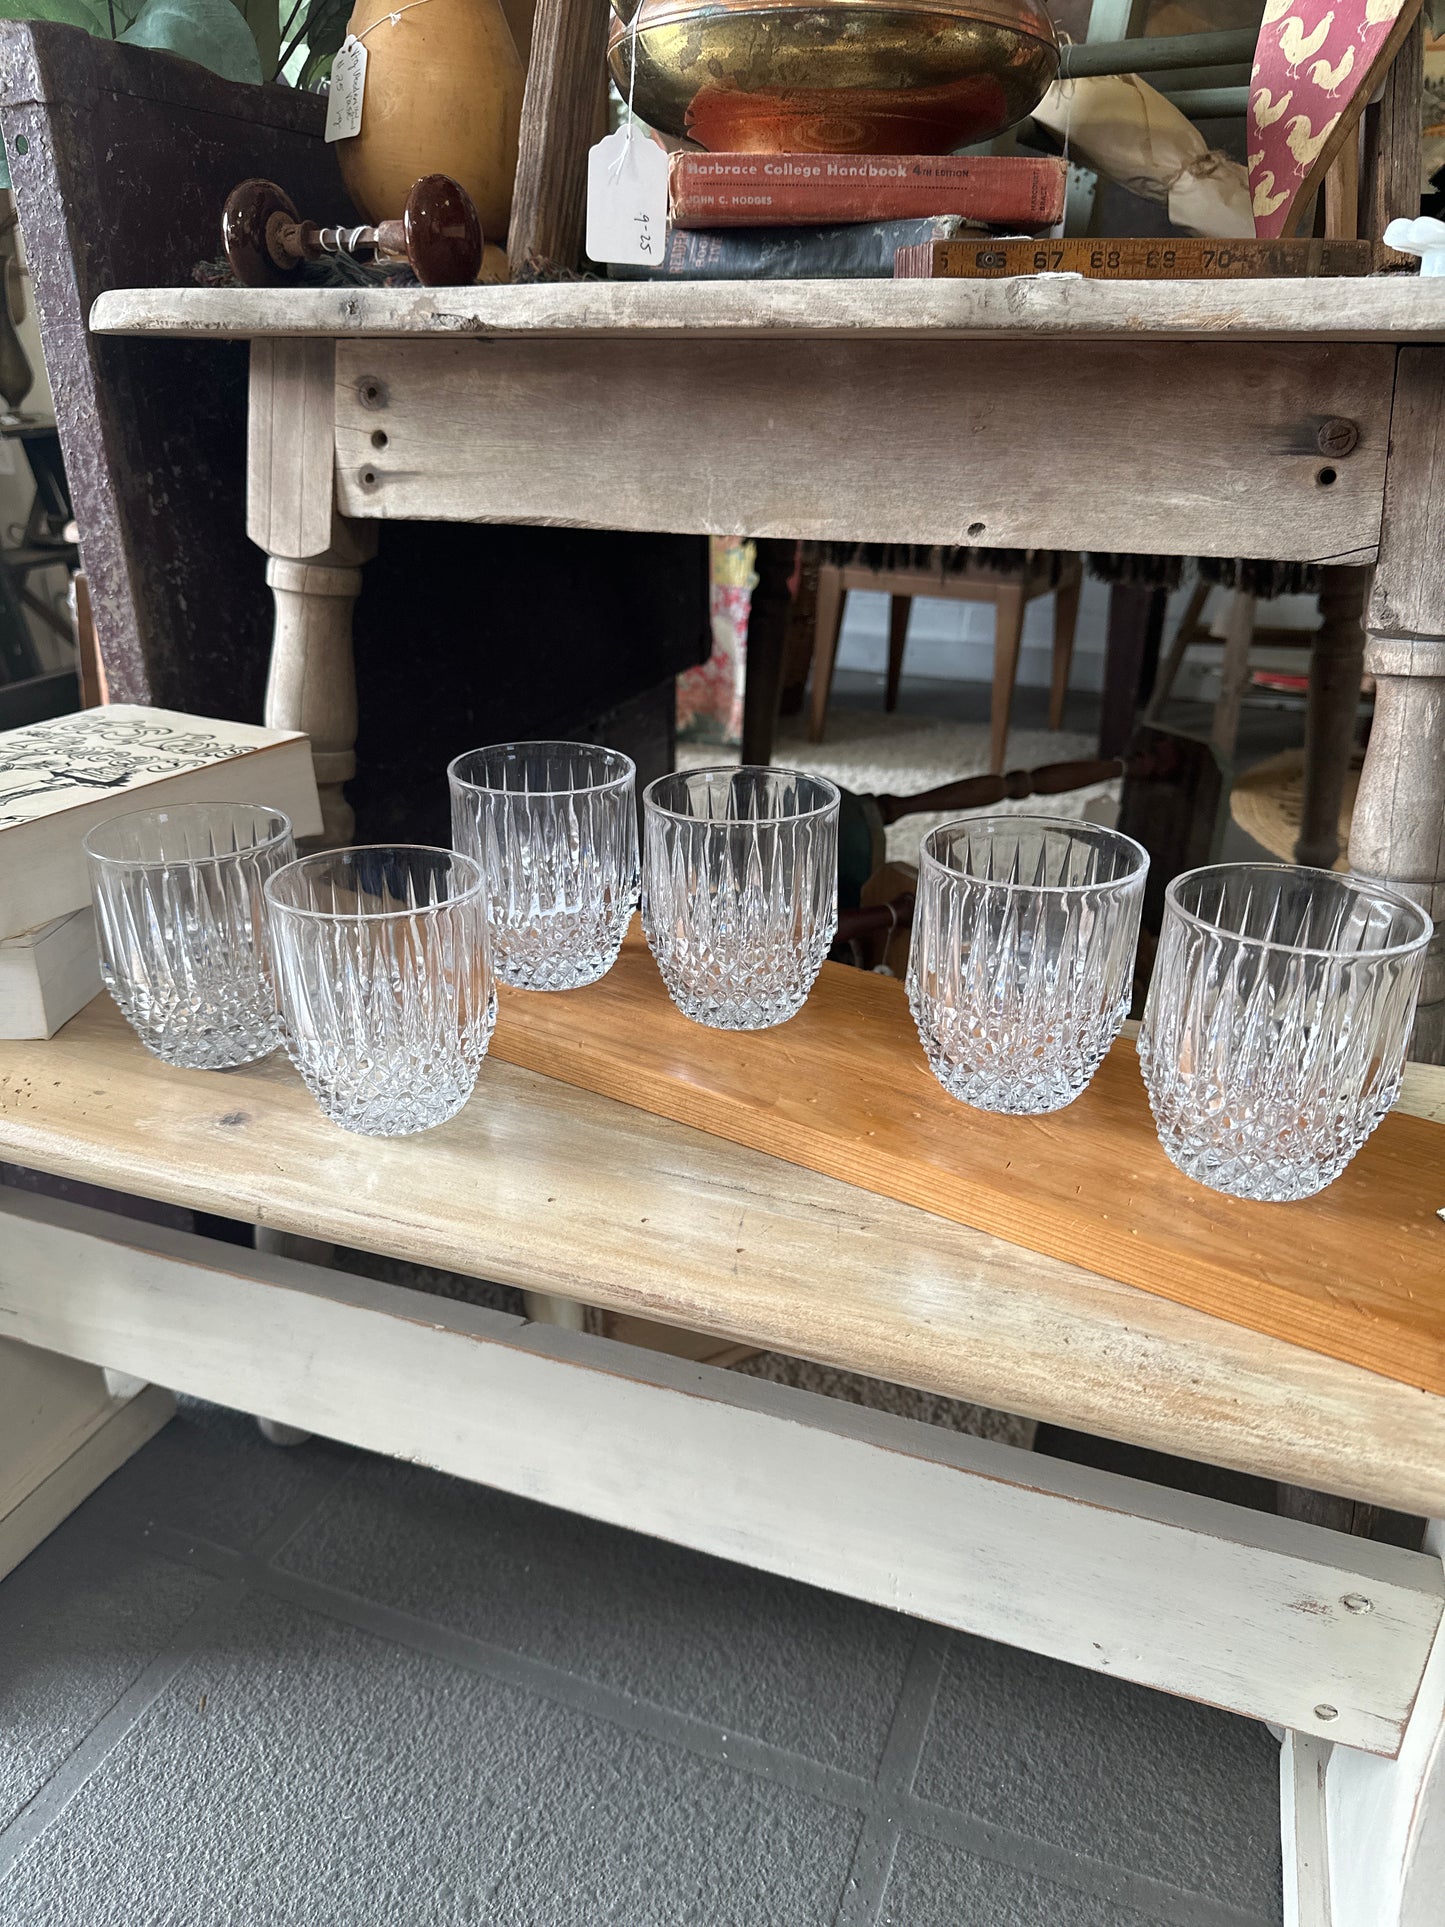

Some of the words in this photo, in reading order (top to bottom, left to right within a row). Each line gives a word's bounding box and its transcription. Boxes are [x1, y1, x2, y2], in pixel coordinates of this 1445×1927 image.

[687, 162, 758, 175] Harbrace
[764, 162, 821, 177] College
[827, 164, 907, 177] Handbook
[688, 195, 715, 205] JOHN
[718, 195, 729, 205] C.
[732, 196, 772, 206] HODGES
[669, 230, 689, 275] READER
[1033, 251, 1064, 269] 67
[1090, 250, 1121, 269] 68
[1203, 250, 1232, 269] 70
